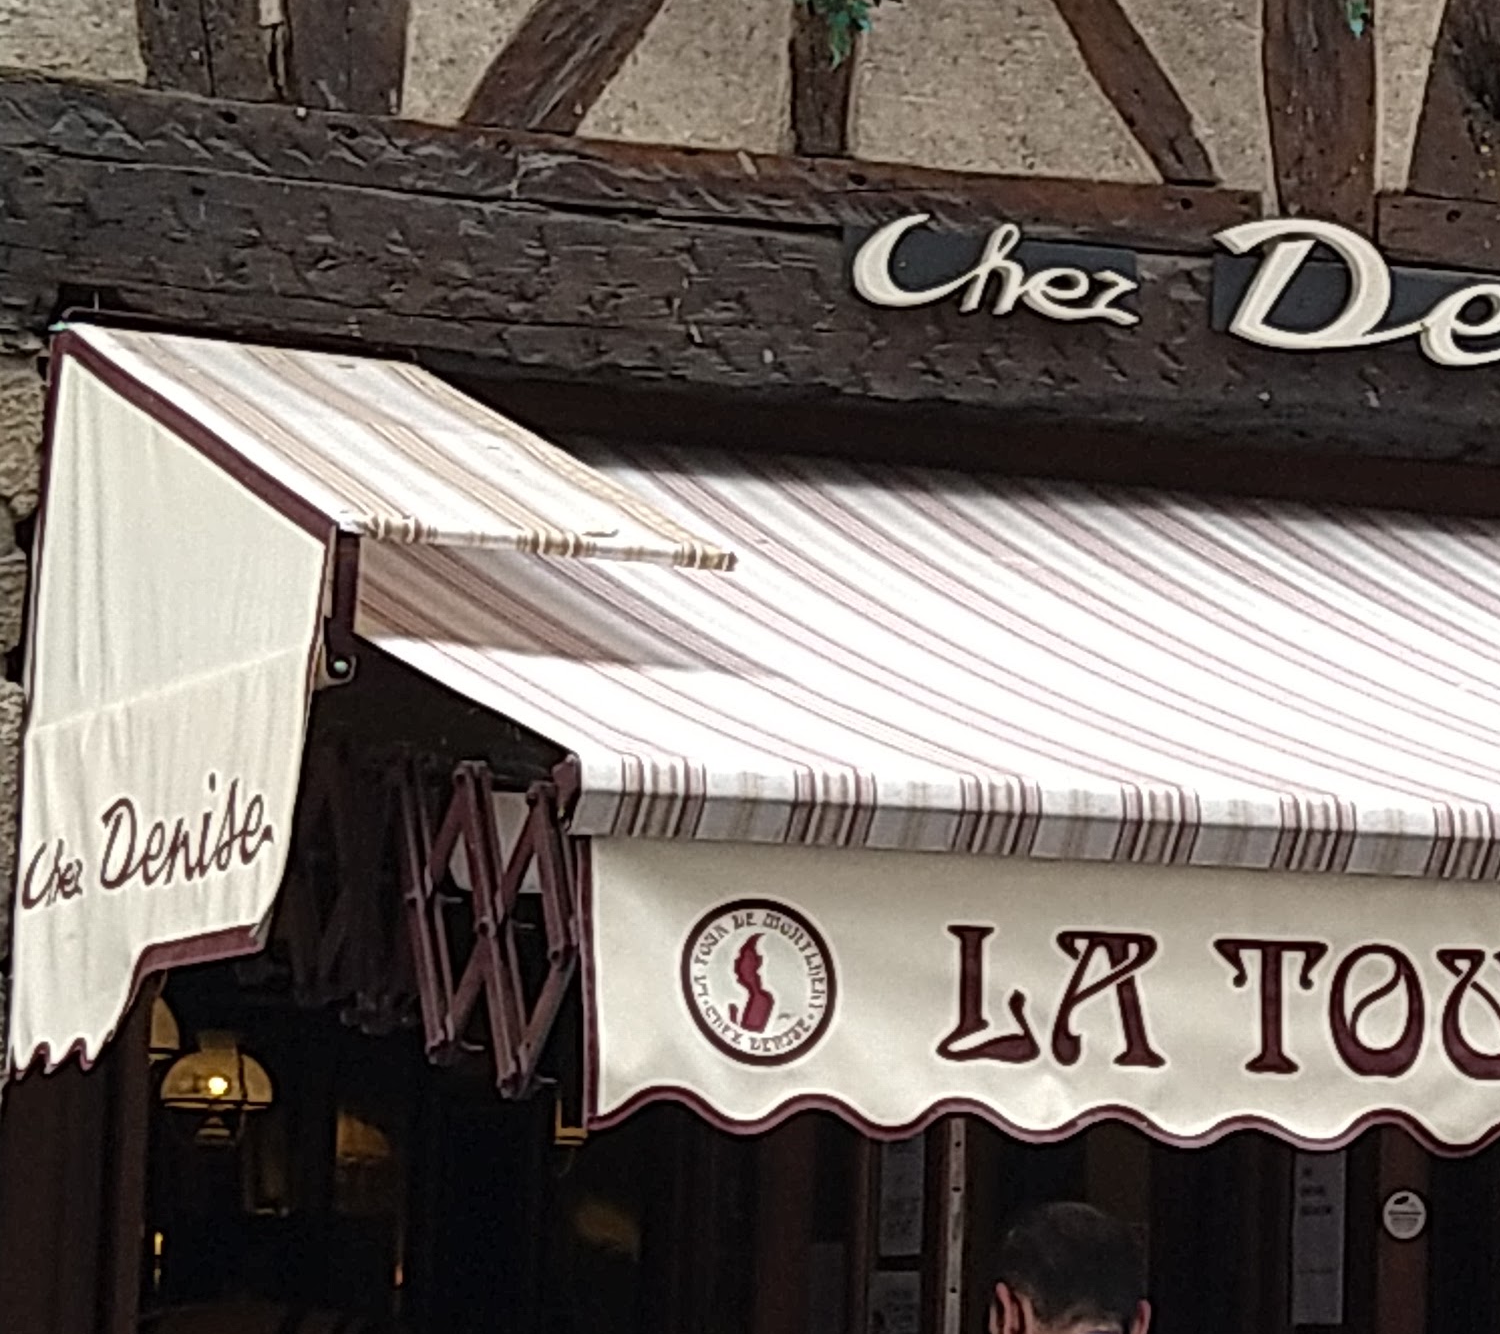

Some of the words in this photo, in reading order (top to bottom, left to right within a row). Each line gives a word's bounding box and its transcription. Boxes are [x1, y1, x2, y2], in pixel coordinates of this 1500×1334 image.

[853, 212, 1140, 327] Chez
[100, 772, 274, 890] Denise
[936, 924, 1166, 1069] LA
